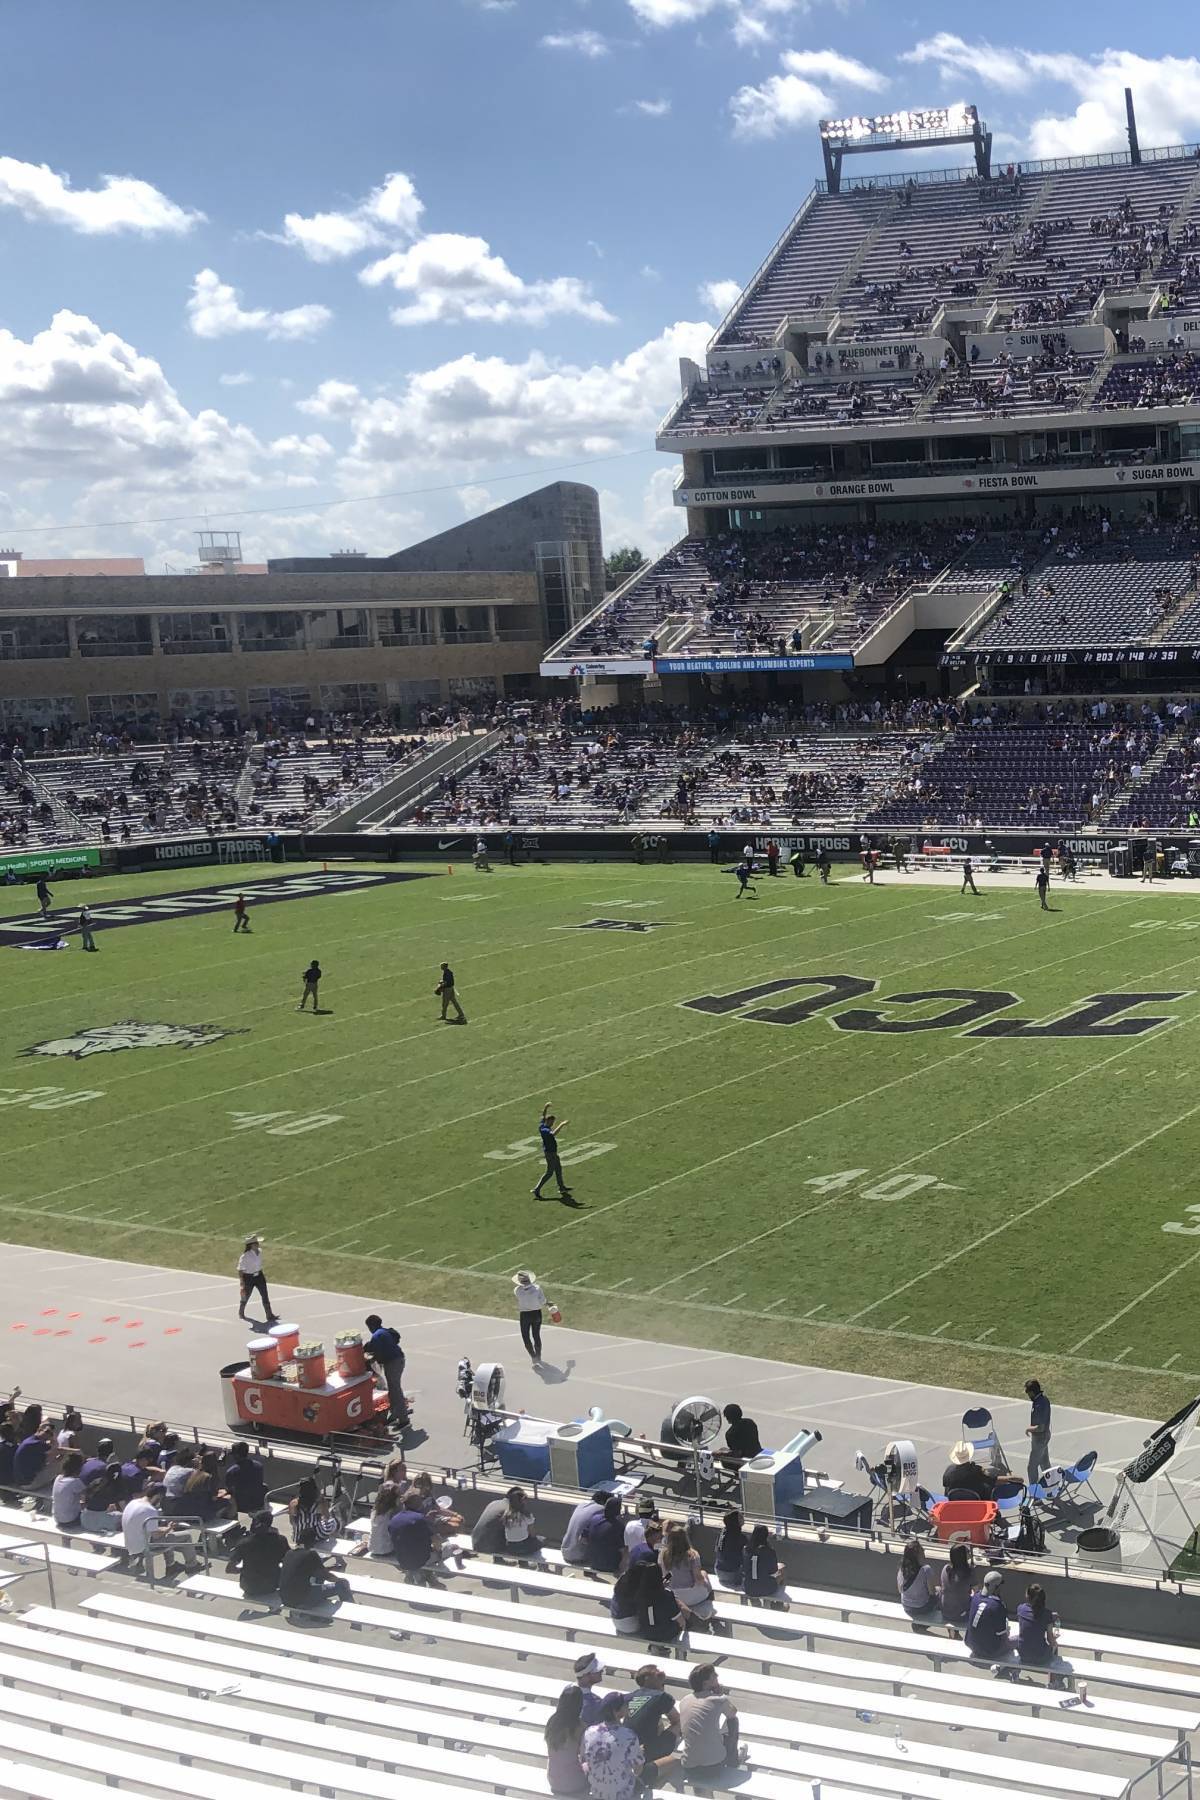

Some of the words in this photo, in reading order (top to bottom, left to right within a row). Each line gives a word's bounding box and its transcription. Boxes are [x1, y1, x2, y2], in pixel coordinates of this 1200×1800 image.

[1020, 334, 1040, 346] SUN
[838, 346, 894, 359] BLUEBONNET
[894, 344, 919, 356] BOWL
[1132, 469, 1164, 480] SUGAR
[1166, 467, 1195, 478] BOWL
[979, 477, 1009, 488] FIESTA
[1011, 475, 1038, 486] BOWL
[694, 491, 729, 502] COTTON
[730, 489, 757, 500] BOWL
[830, 484, 867, 496] ORANGE
[868, 482, 895, 494] BOWL
[985, 655, 990, 663] 7
[1031, 655, 1037, 663] 0
[1054, 654, 1067, 662] 115
[1096, 653, 1113, 661] 203
[1129, 652, 1144, 661] 148
[1161, 651, 1178, 660] 351
[669, 662, 687, 671] YOUR
[687, 661, 714, 671] HEATING,
[715, 661, 741, 670] COOLING
[742, 660, 755, 669] AND
[756, 660, 788, 669] PLUMBING
[789, 659, 815, 668] EXPERTS
[156, 842, 212, 859] HORNED
[217, 839, 261, 853] FROGS
[755, 837, 805, 850] HORNED
[809, 837, 850, 850] FROGS
[940, 837, 969, 851] TCU
[9, 862, 27, 870] Health
[30, 859, 55, 867] SPORTS
[55, 855, 87, 864] MEDICINE
[674, 974, 1197, 1041] TCU
[228, 1110, 345, 1136] 40
[482, 1135, 618, 1167] 50
[802, 1168, 938, 1201] 40
[244, 1387, 264, 1415] G
[346, 1397, 361, 1417] G
[903, 1462, 916, 1470] BIG
[1130, 1441, 1171, 1479] ROGERS
[751, 1555, 758, 1580] 1
[647, 1606, 655, 1626] 1
[971, 1601, 988, 1628] 1
